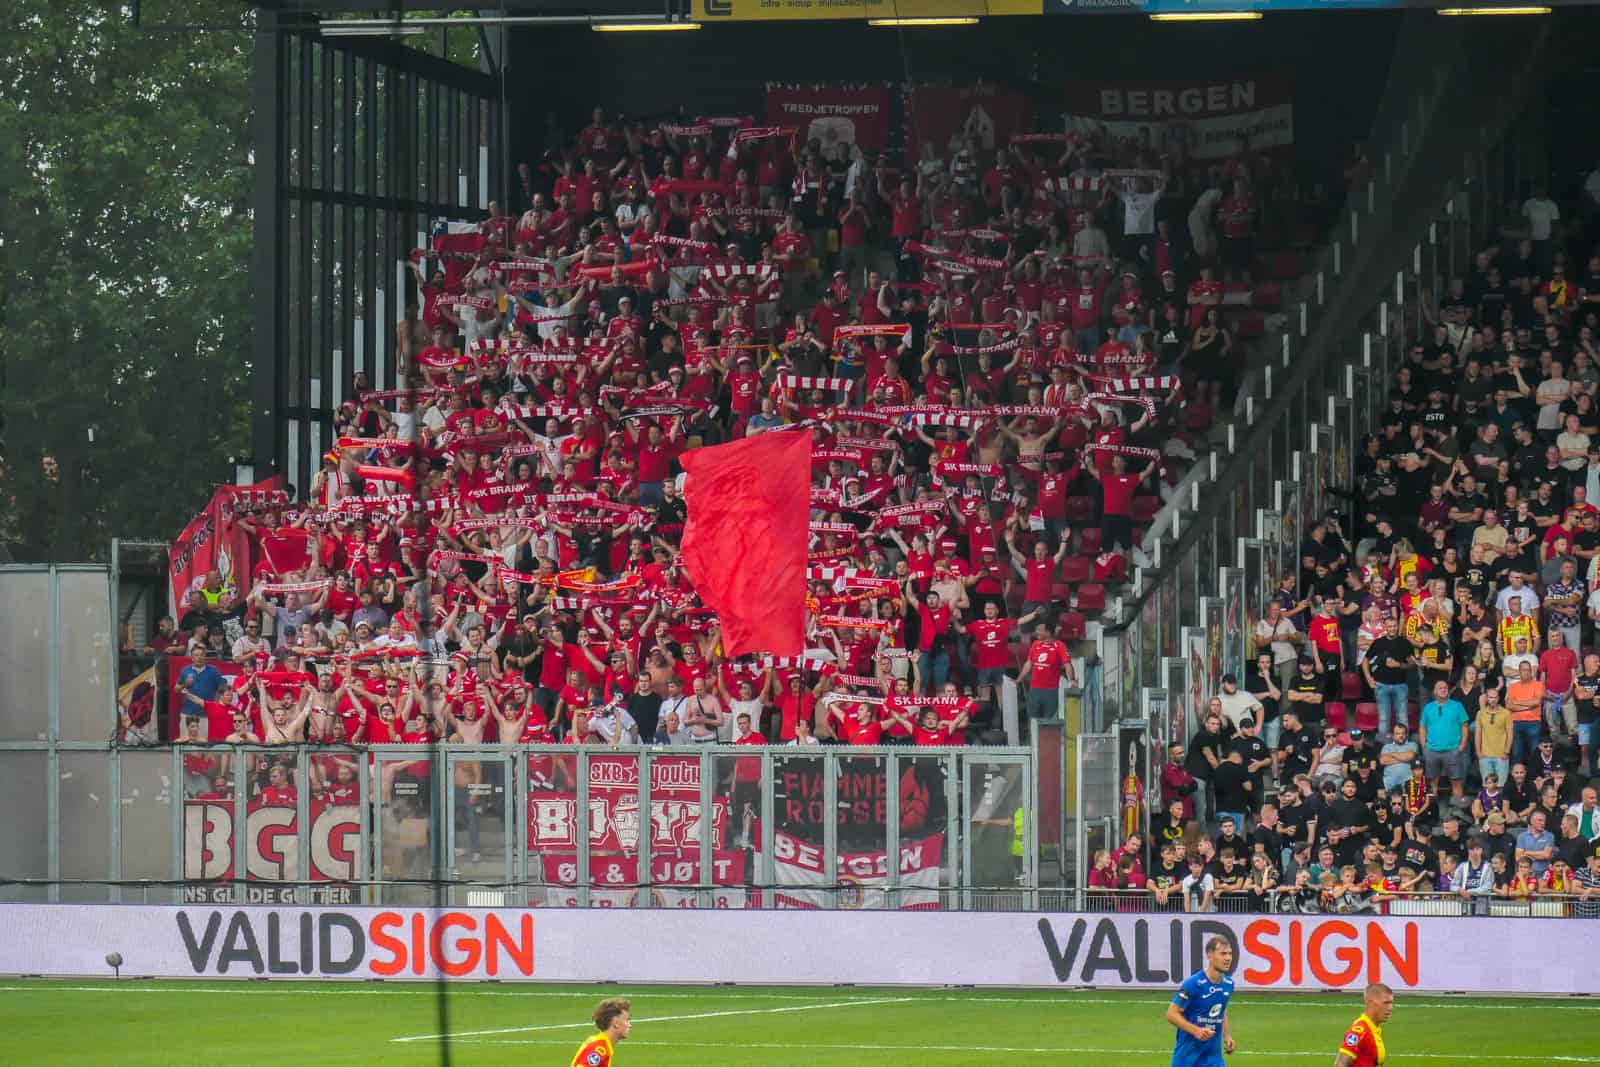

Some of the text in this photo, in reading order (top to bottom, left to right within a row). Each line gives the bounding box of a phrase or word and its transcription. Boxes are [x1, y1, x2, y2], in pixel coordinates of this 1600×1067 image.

[1100, 80, 1256, 115] BERGEN
[782, 102, 881, 115] TREDJETROPPEN
[1103, 353, 1146, 364] BRANN
[994, 406, 1011, 416] SK
[1014, 406, 1061, 417] BRANN
[943, 464, 992, 477] SK BRANN
[474, 484, 529, 499] SK BRANN
[364, 494, 412, 505] BRANN
[893, 696, 912, 706] SK
[914, 695, 958, 706] BRANN
[184, 803, 362, 881] BGG
[213, 886, 275, 903] GLDE
[175, 910, 535, 978] VALIDSIGN
[1036, 916, 1419, 987] VALIDSIGN
